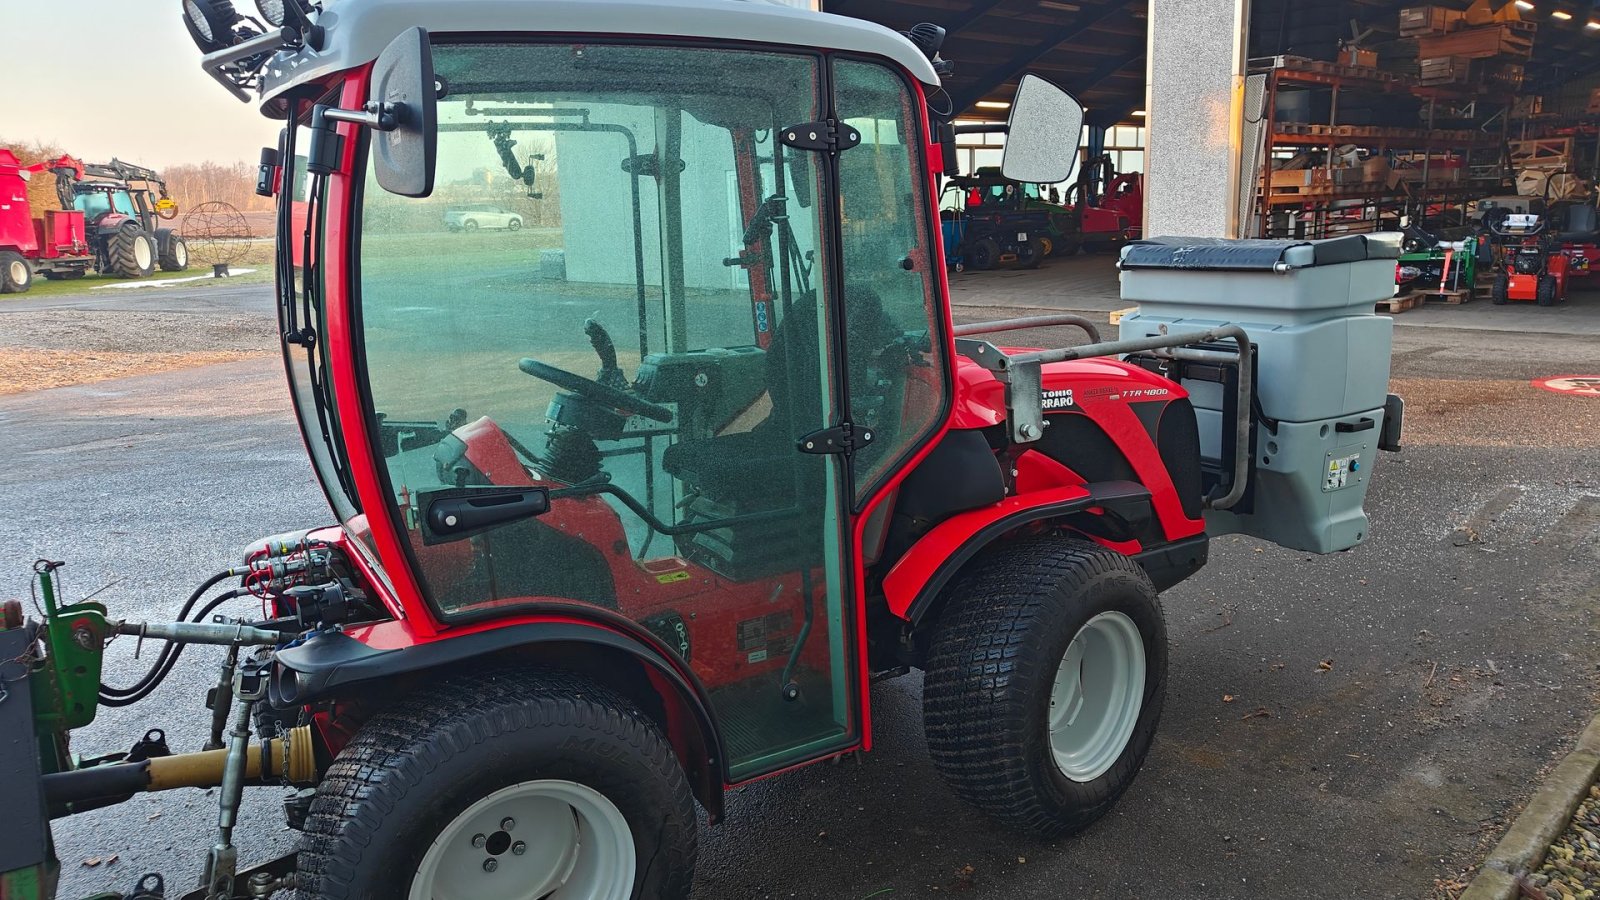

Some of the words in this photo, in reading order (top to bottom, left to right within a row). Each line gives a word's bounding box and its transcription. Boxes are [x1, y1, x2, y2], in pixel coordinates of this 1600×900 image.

[1042, 389, 1073, 397] TONIO
[1143, 388, 1168, 396] 4800
[1042, 397, 1074, 408] RRARO
